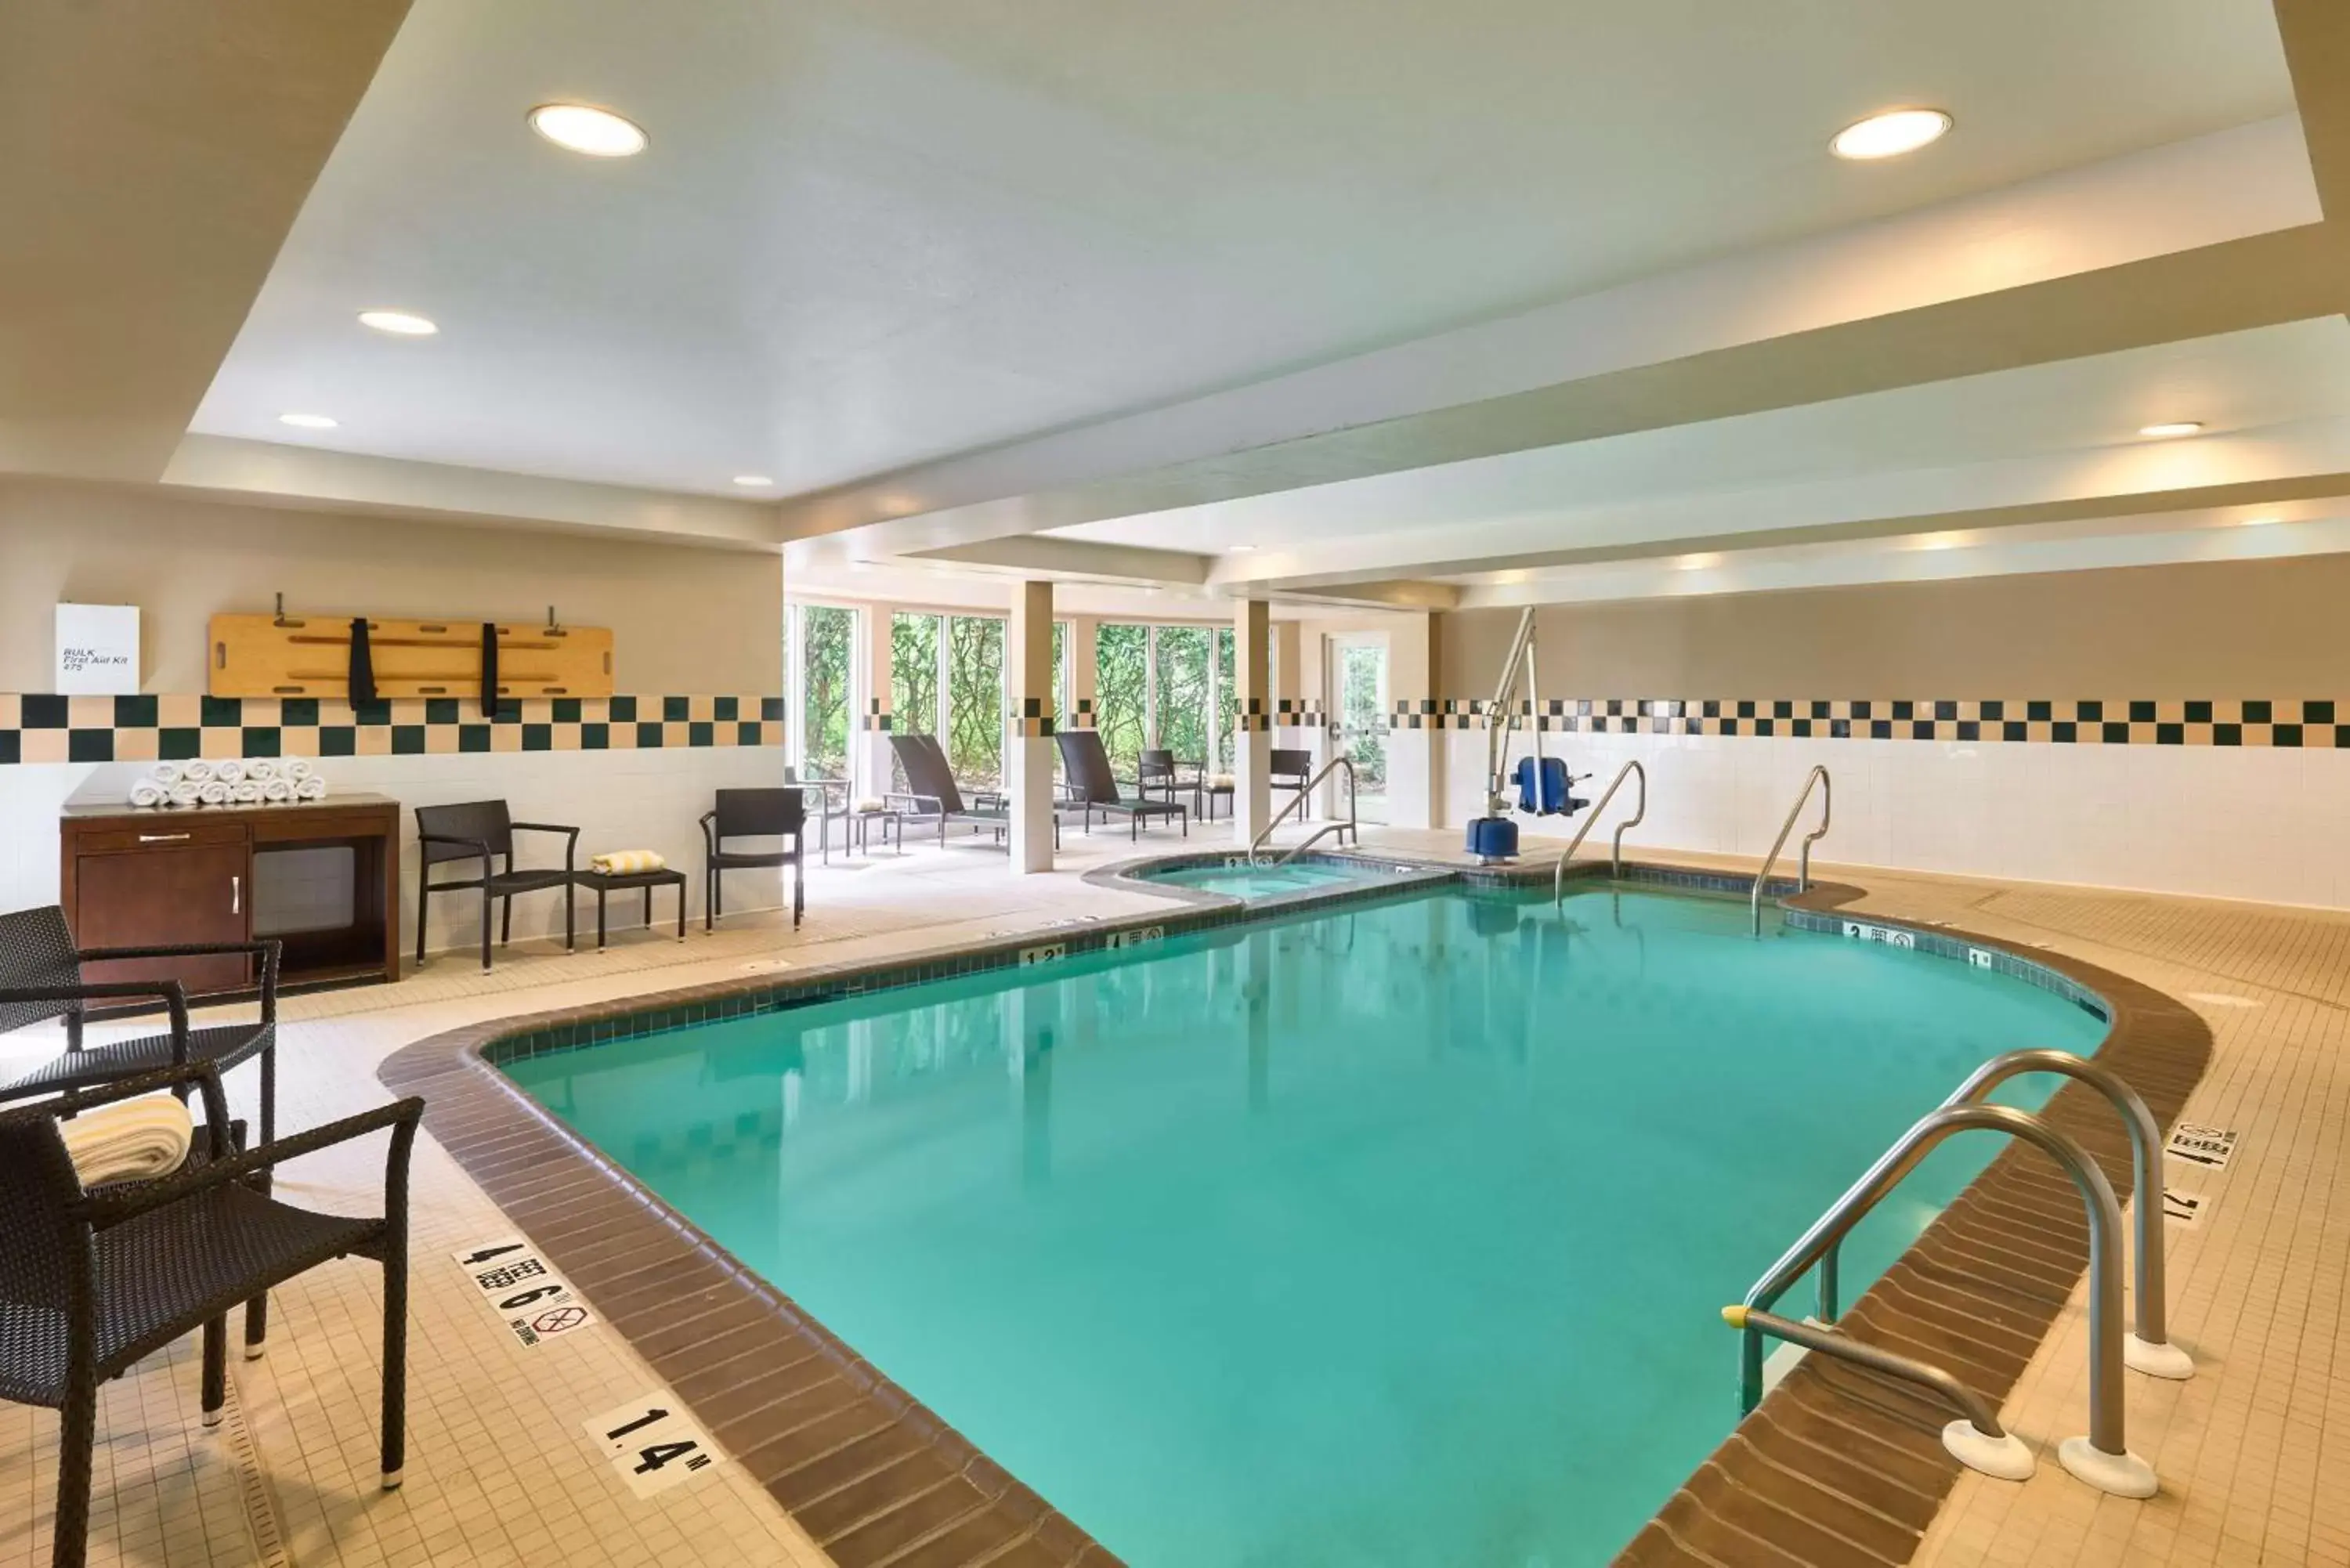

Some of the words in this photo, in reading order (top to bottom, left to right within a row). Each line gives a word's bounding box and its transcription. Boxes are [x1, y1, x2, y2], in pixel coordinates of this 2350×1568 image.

[63, 649, 96, 657] BULK
[463, 1243, 525, 1265] 4
[475, 1267, 516, 1290] DEEP
[508, 1258, 548, 1281] FEET
[499, 1285, 562, 1310] 6
[685, 1453, 712, 1472] M
